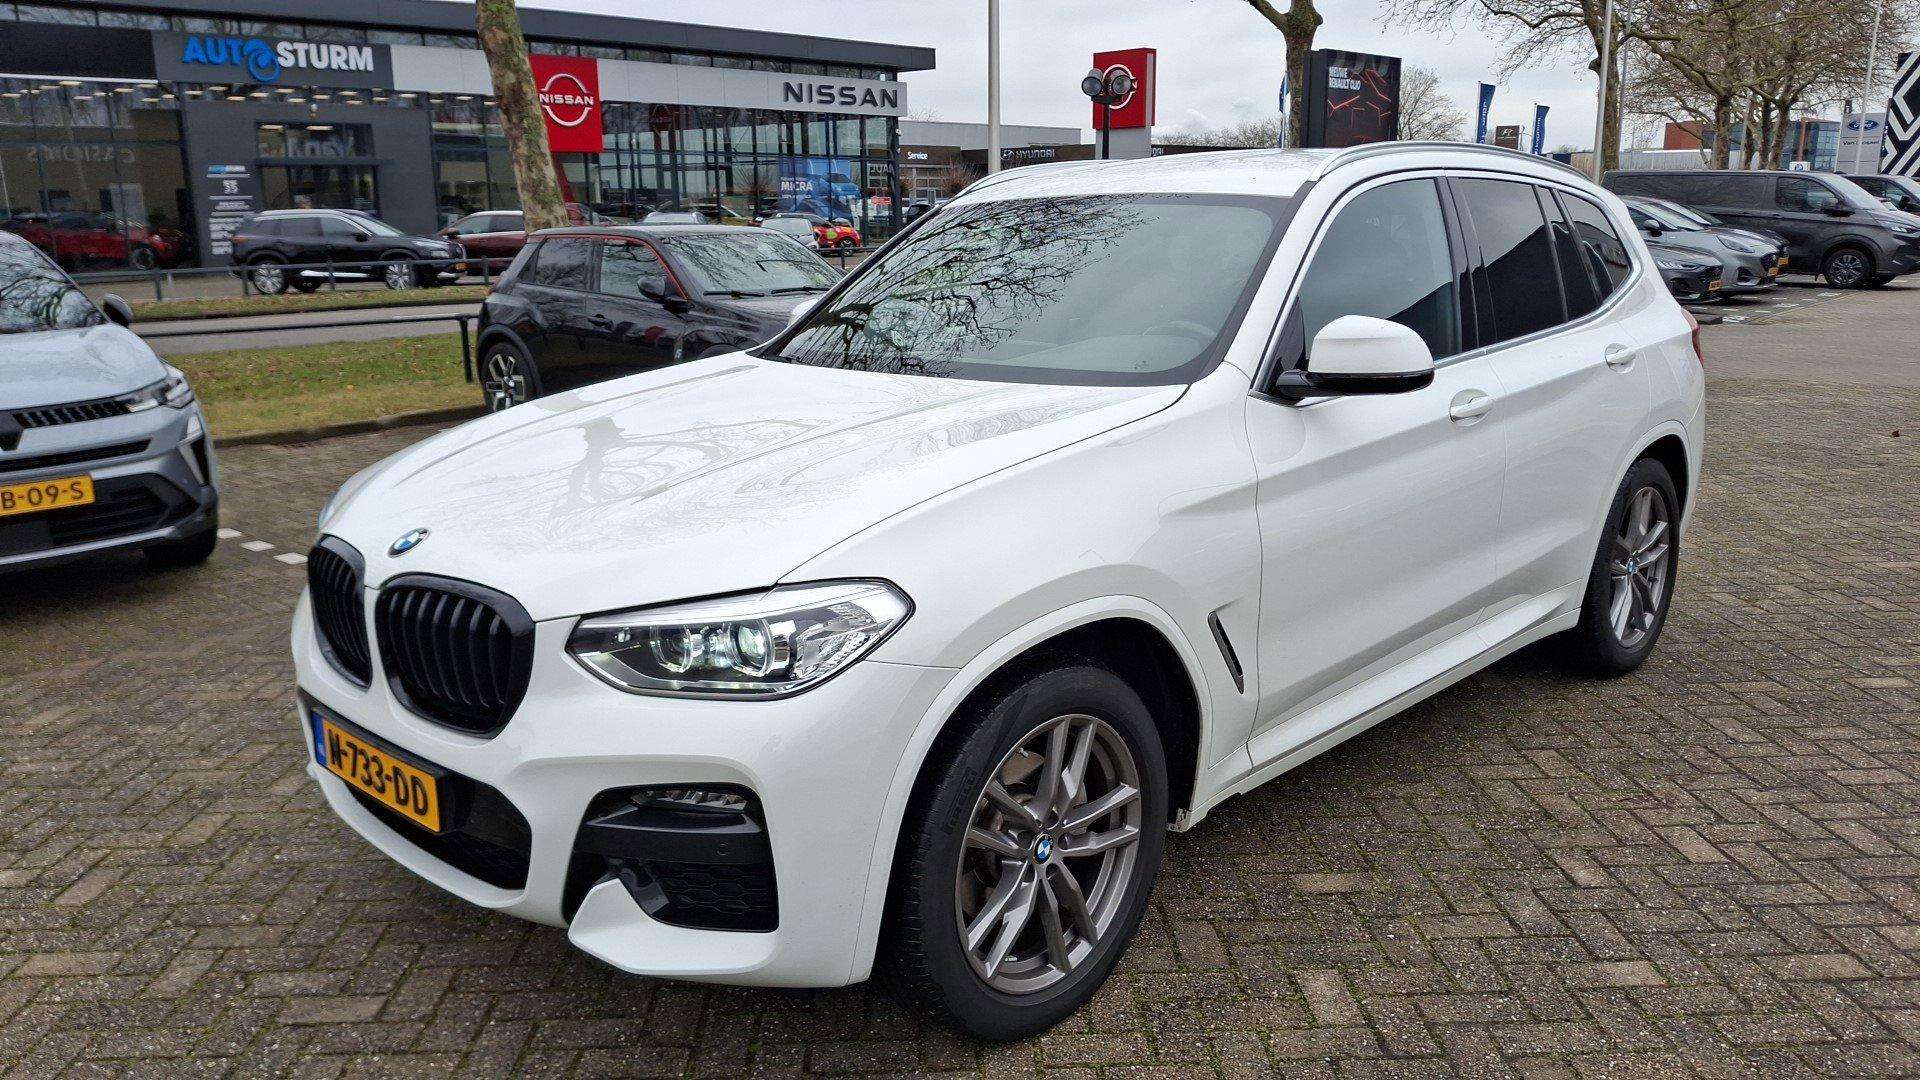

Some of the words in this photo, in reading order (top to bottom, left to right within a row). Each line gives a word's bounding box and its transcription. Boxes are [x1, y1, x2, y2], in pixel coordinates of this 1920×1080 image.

[539, 93, 594, 106] NISSAN
[783, 81, 898, 108] NISSAN
[907, 151, 929, 160] Service
[1015, 149, 1056, 159] HYUNDAI
[781, 181, 813, 191] MICRA
[0, 480, 84, 509] B-09-S
[327, 728, 429, 817] N-733-DD
